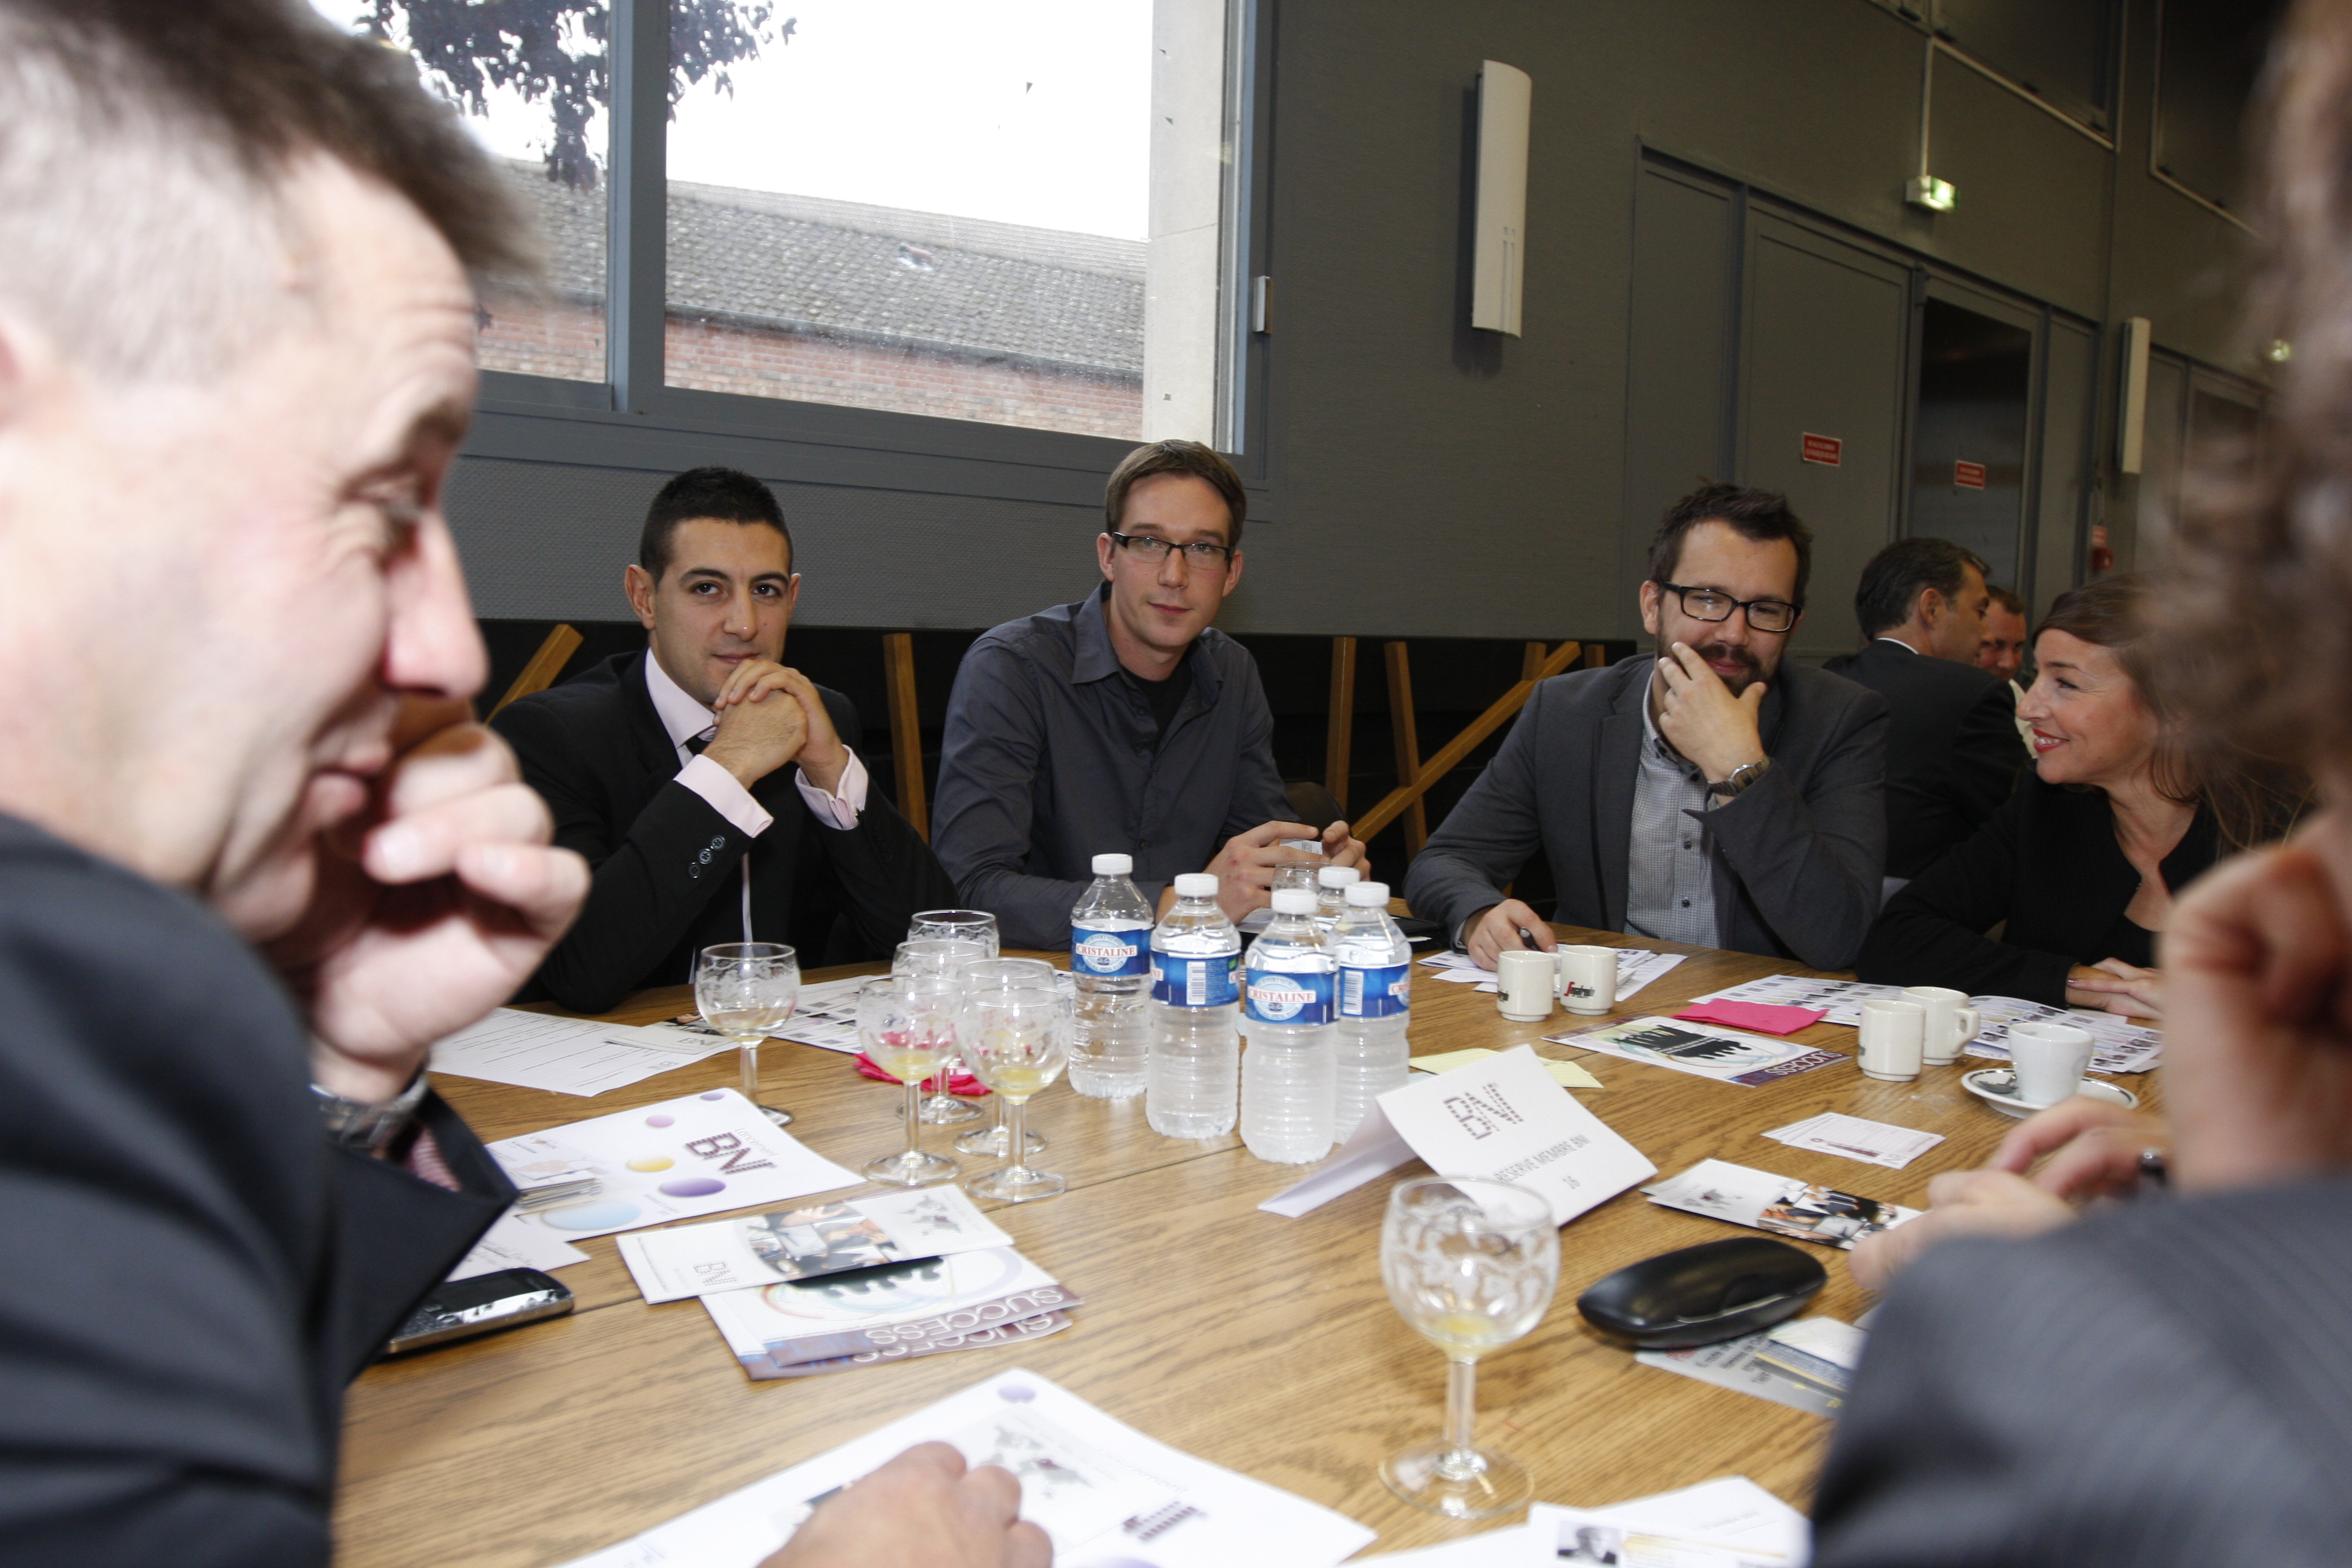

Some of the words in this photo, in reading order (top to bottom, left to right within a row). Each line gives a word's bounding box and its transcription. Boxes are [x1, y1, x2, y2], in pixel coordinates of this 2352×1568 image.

[1076, 945, 1135, 957] CRISTALINE
[1249, 988, 1314, 1002] CRISTALINE
[1494, 1158, 1540, 1183] RESERVE
[1532, 1141, 1578, 1166] MEMBRE
